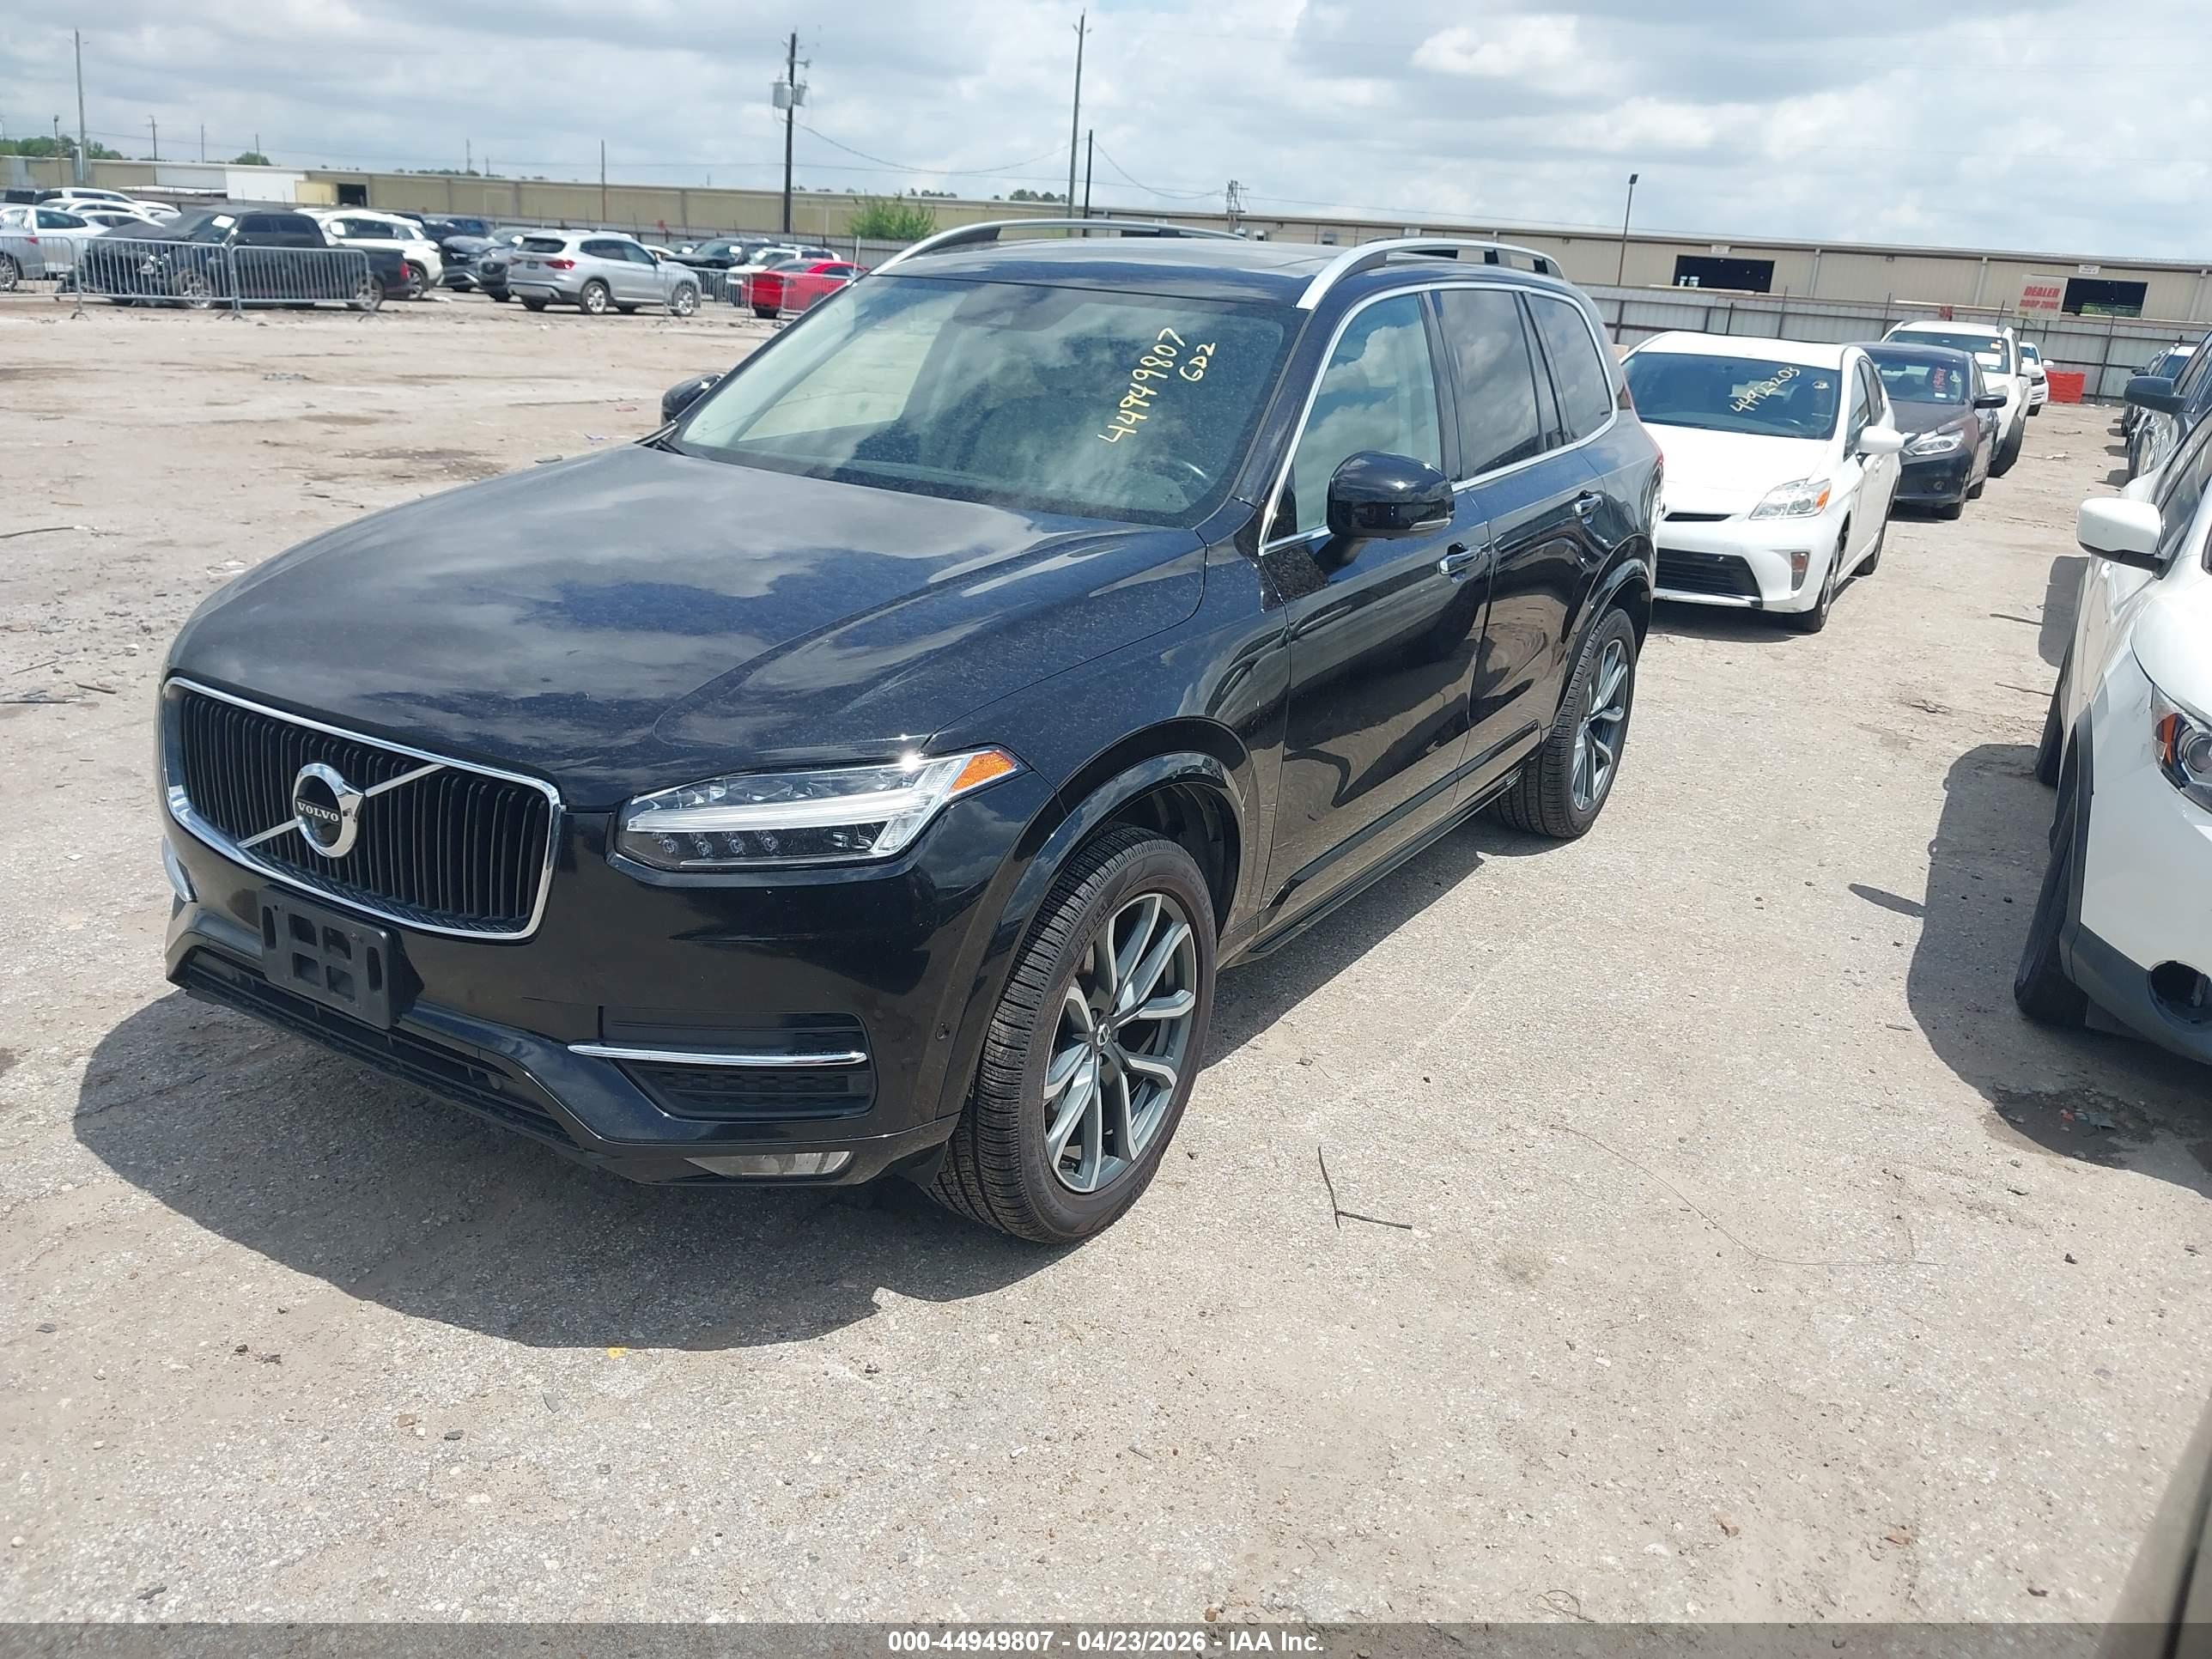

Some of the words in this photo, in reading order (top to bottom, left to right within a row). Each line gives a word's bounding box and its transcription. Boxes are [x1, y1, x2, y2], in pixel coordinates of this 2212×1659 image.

[2023, 286, 2061, 297] DEALER
[1097, 327, 1186, 443] 44949807
[296, 800, 339, 822] VOLVO
